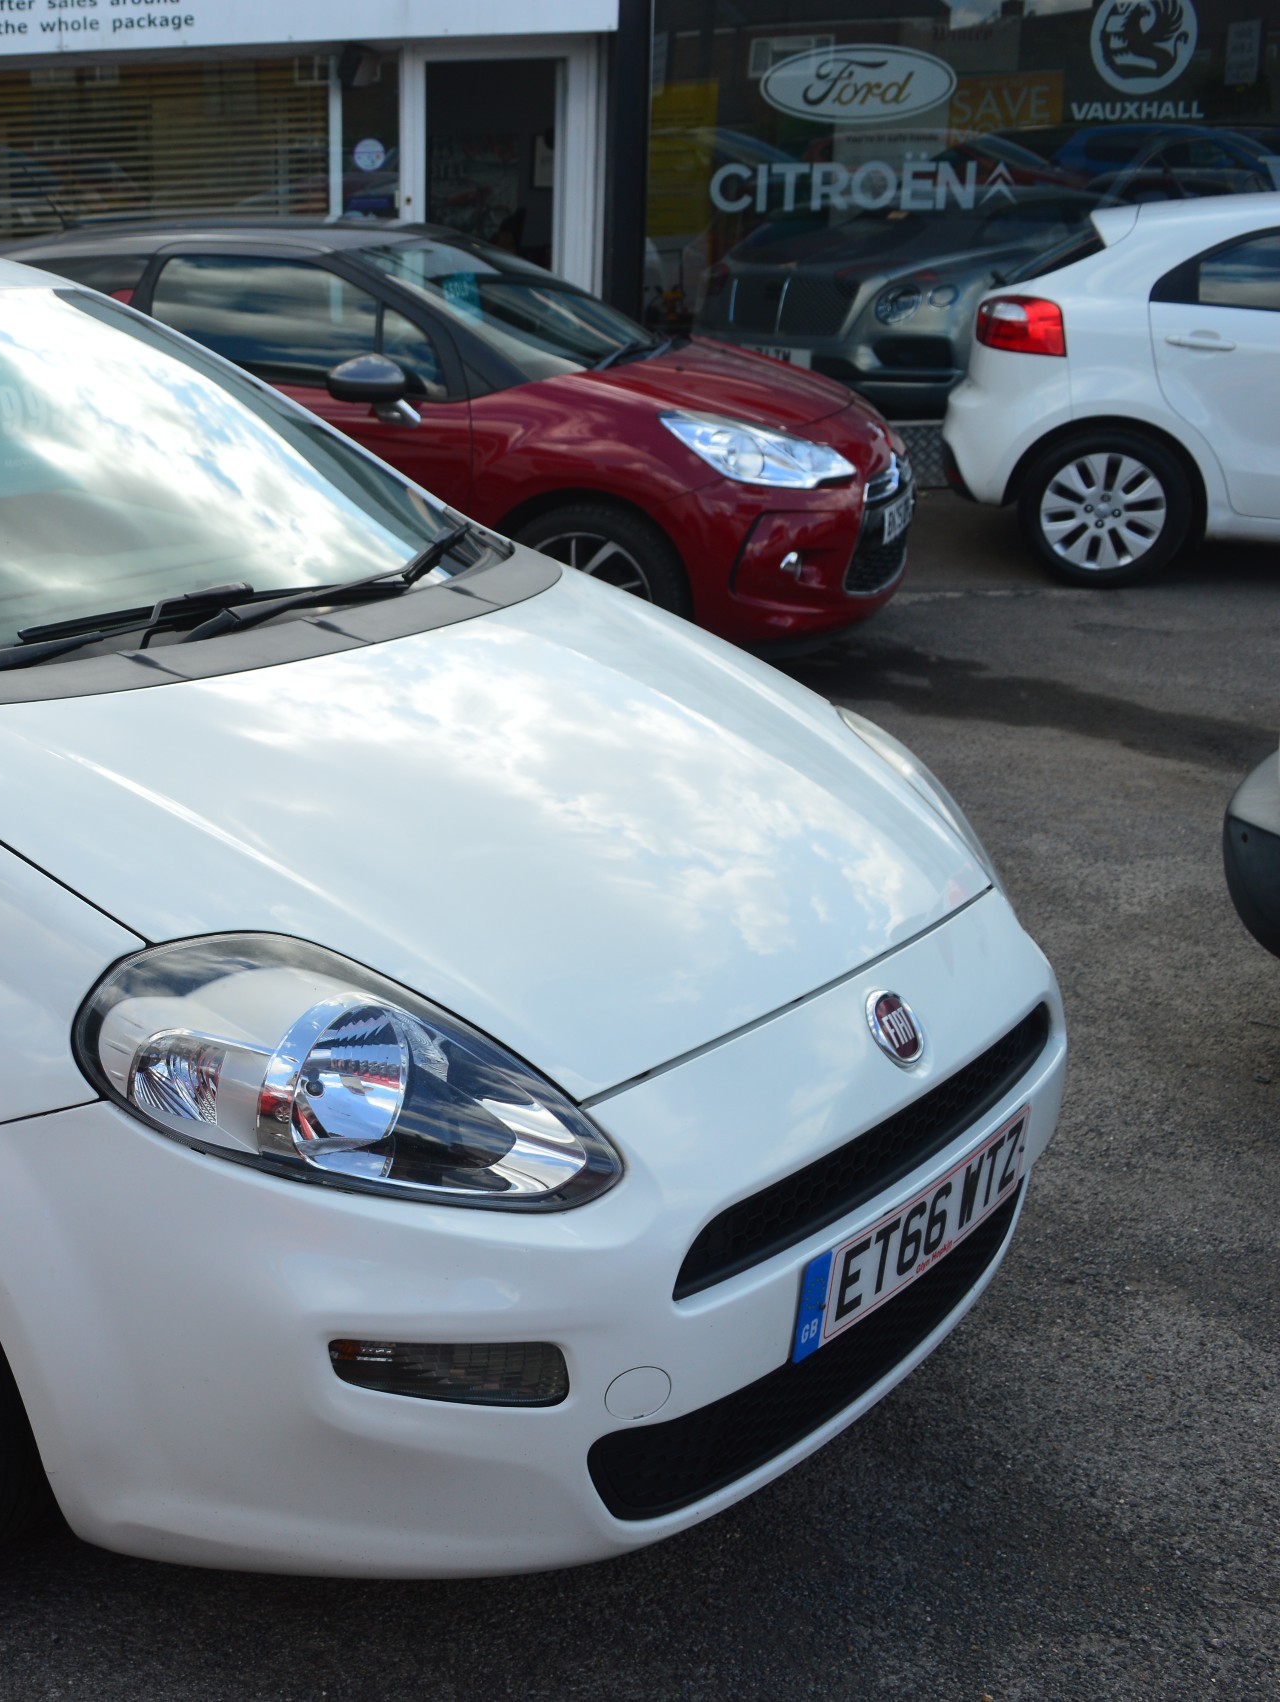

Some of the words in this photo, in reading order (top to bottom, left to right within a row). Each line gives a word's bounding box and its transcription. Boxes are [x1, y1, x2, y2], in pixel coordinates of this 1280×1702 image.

[40, 16, 100, 33] whole
[112, 13, 195, 33] package
[47, 0, 98, 9] sales
[802, 58, 916, 106] Ford
[951, 83, 1052, 125] SAVE
[1071, 100, 1205, 121] VAUXHALL
[709, 150, 978, 213] CITROËN
[881, 1006, 915, 1049] FIAT
[834, 1181, 953, 1323] ET66
[957, 1116, 1026, 1231] WTZ
[801, 1318, 819, 1345] GB
